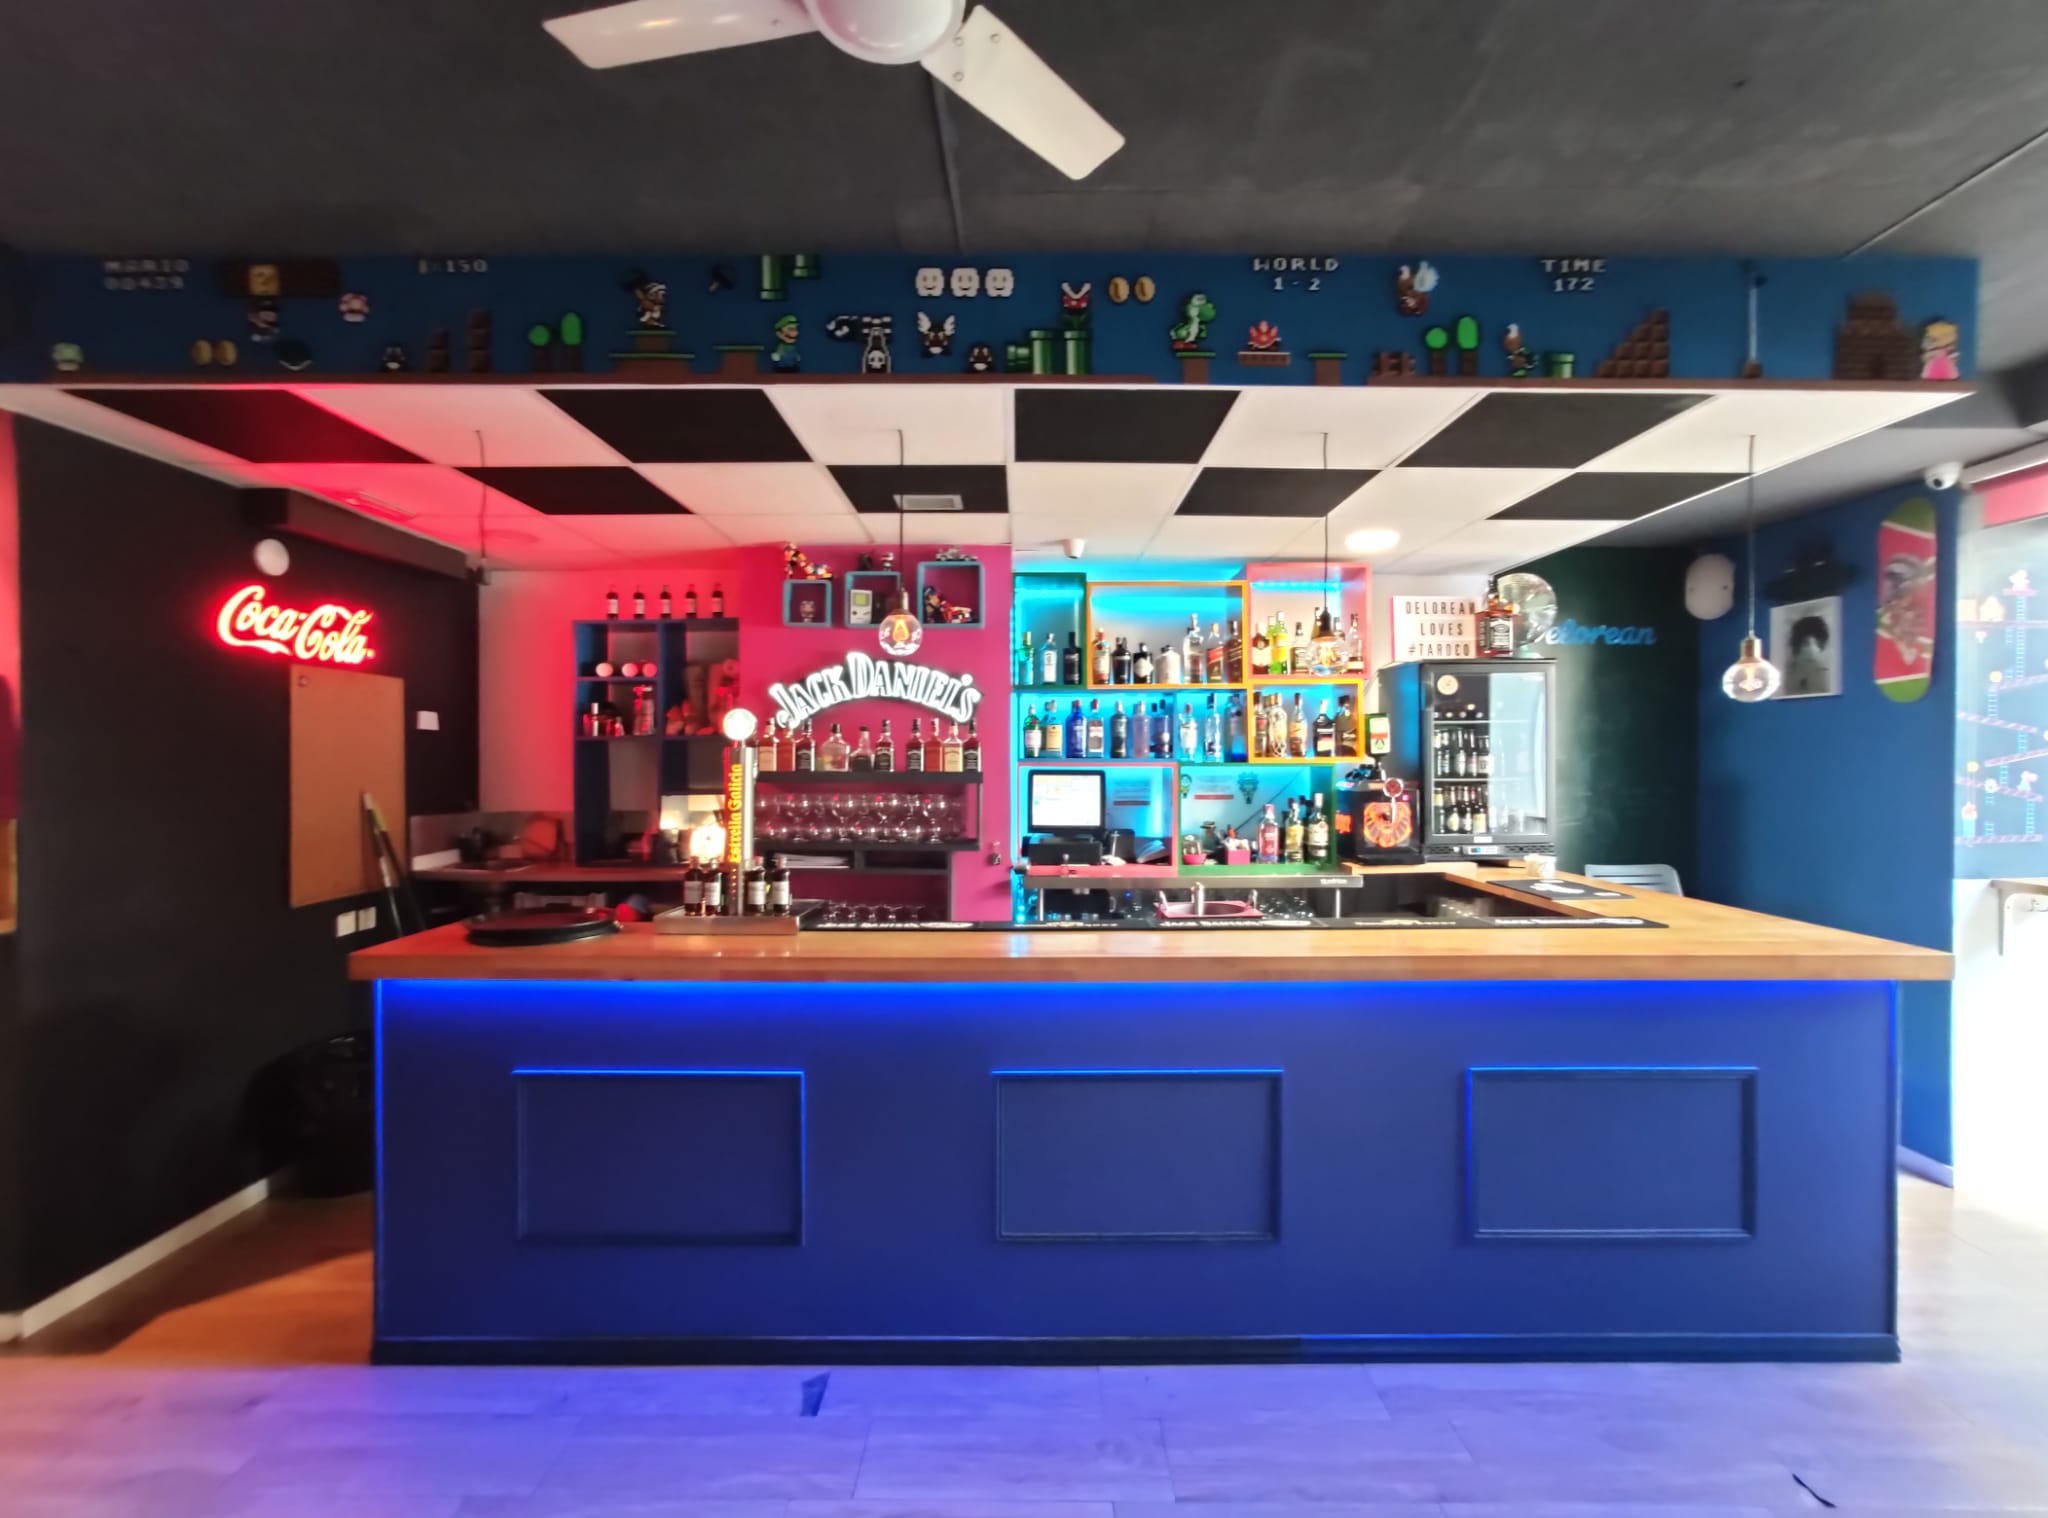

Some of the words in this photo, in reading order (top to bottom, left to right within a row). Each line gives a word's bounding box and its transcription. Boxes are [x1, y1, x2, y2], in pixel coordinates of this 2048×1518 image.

[1252, 257, 1340, 272] WORLD
[1540, 258, 1609, 273] TIME
[1553, 277, 1596, 293] 172
[1405, 601, 1476, 615] DELOREAN
[1420, 622, 1464, 636] LOVES
[768, 664, 848, 730] JACK
[727, 763, 743, 811] Galicia
[728, 812, 743, 865] Estrella
